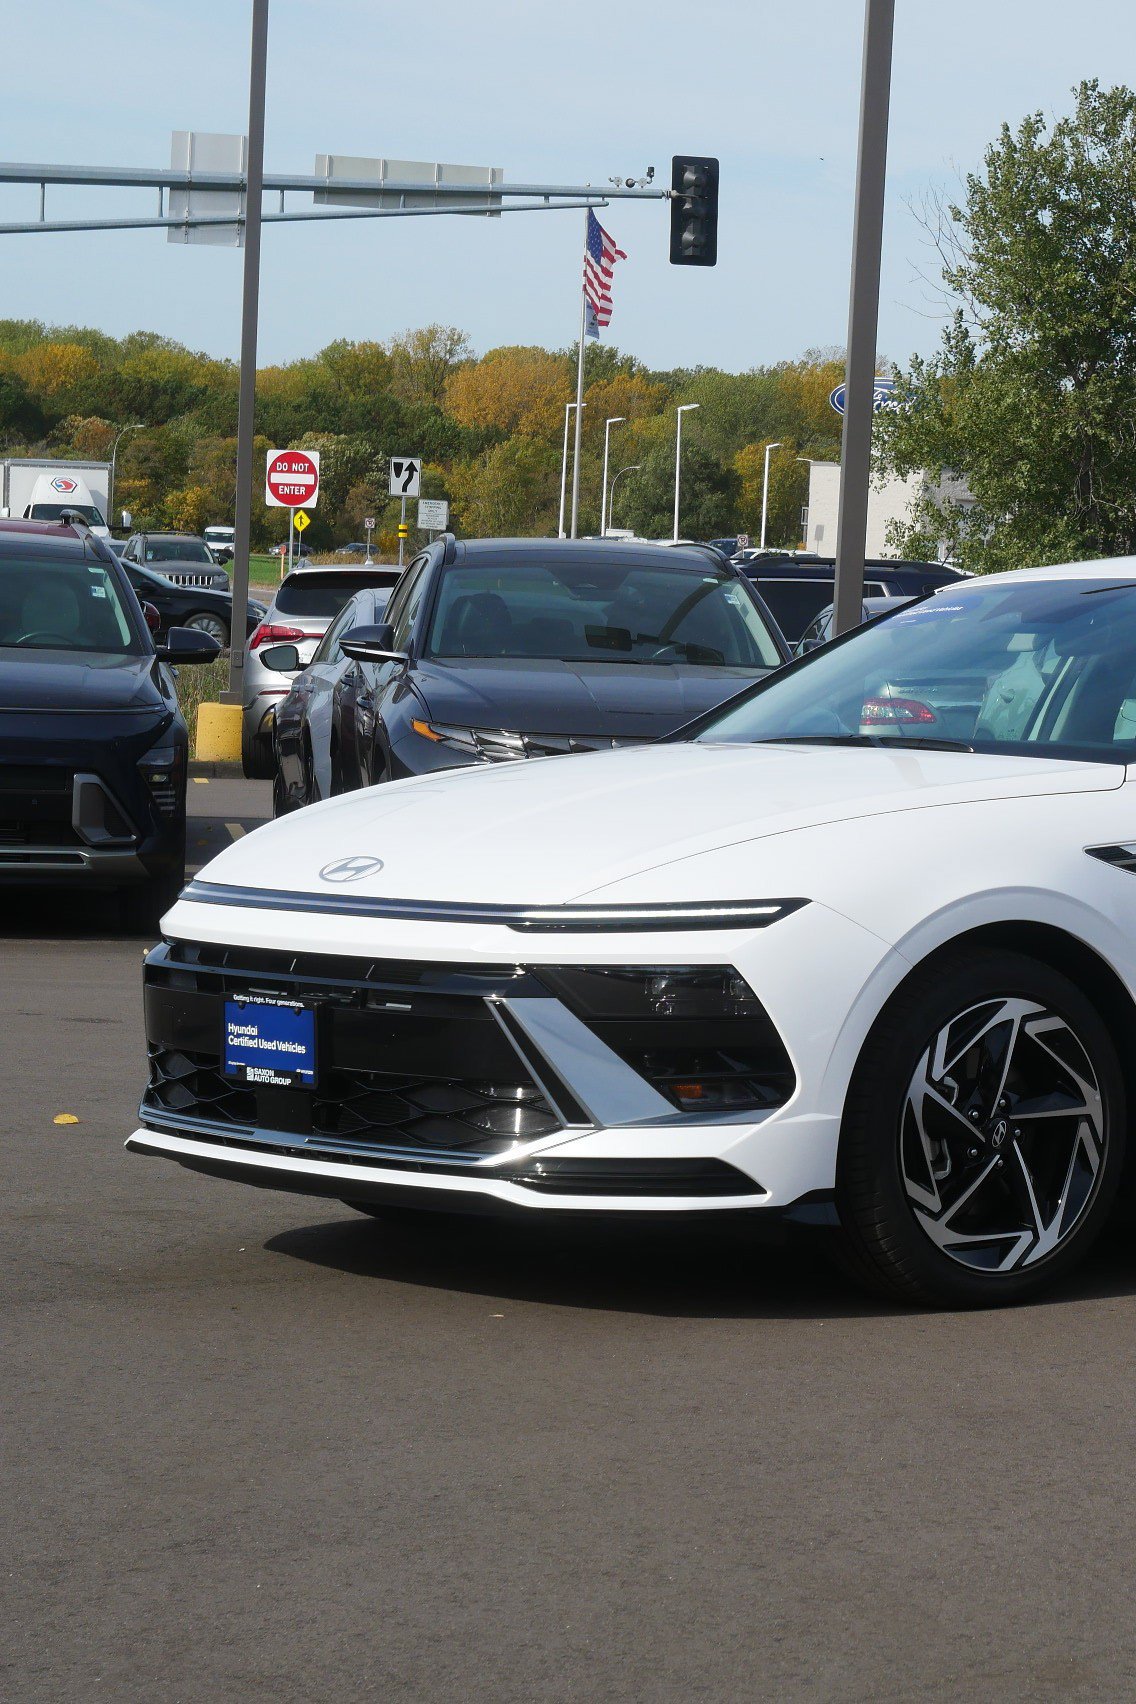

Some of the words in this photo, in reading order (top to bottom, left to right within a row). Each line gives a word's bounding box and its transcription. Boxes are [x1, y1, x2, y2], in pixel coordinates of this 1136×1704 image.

[276, 462, 288, 471] DO
[292, 463, 309, 472] NOT
[278, 485, 306, 495] ENTER
[228, 1022, 258, 1036] Hyundai
[228, 1035, 258, 1048] Certified
[258, 1038, 276, 1051] Used
[277, 1040, 306, 1054] Vehicles
[254, 1067, 275, 1077] SAXON
[254, 1074, 270, 1083] AUTO
[270, 1076, 292, 1086] GROUP
